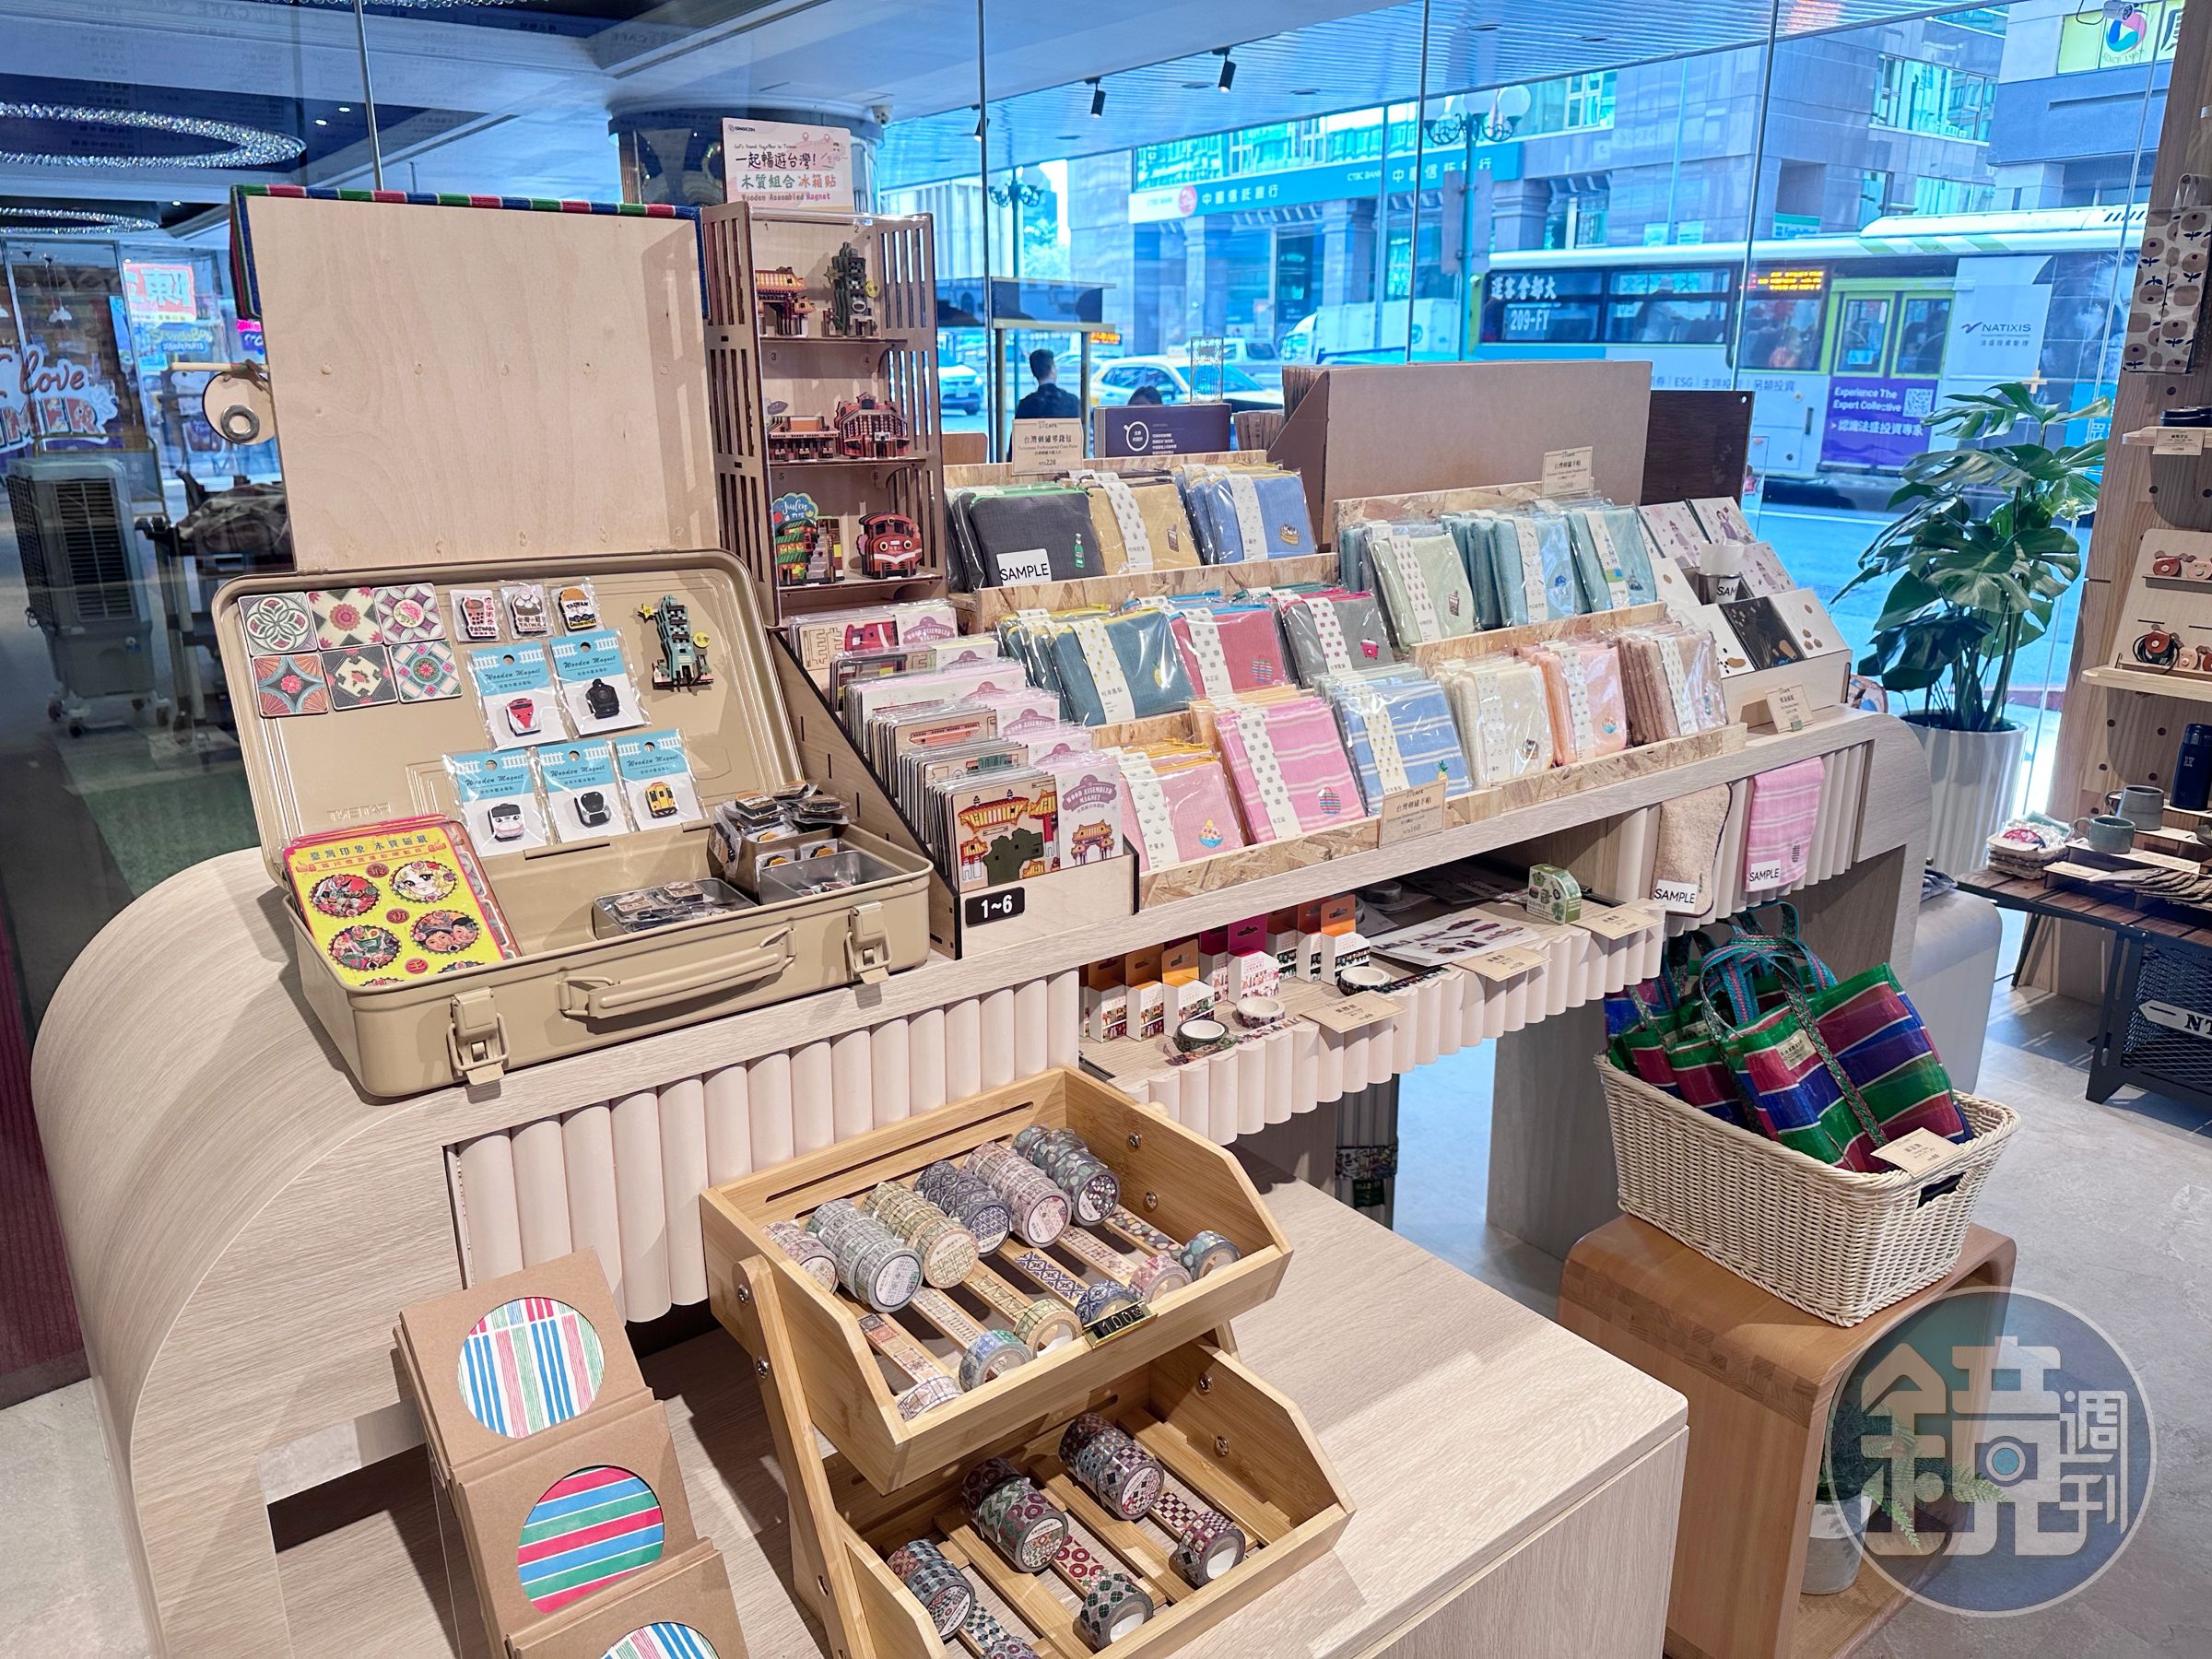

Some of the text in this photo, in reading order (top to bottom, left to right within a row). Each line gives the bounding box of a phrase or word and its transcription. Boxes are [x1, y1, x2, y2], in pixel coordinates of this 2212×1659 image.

[741, 194, 766, 202] Wooden
[806, 192, 831, 201] Magnet
[1202, 184, 1278, 206] 中國信託銀行
[1982, 324, 2031, 333] NATIXIS
[1674, 377, 1694, 388] ESG
[1835, 386, 1898, 399] Experience The
[1833, 399, 1855, 411] Expert
[782, 499, 807, 514] Jiufen
[1000, 563, 1050, 582] SAMPLE
[563, 655, 617, 669] Wooden Magnet
[484, 667, 541, 681] Wooden Magnet
[626, 754, 679, 768] Wooden Magnet
[549, 764, 606, 778] Wooden Magnet
[465, 772, 524, 787] Wooden Magnet
[1065, 785, 1113, 804] WOOD ASSEMBLED
[1079, 794, 1101, 804] MAGNET
[310, 844, 366, 862] 臺灣印象
[1748, 867, 1780, 882] SAMPLE
[1653, 888, 1696, 904] SAMPLE
[981, 893, 1013, 920] 1~6
